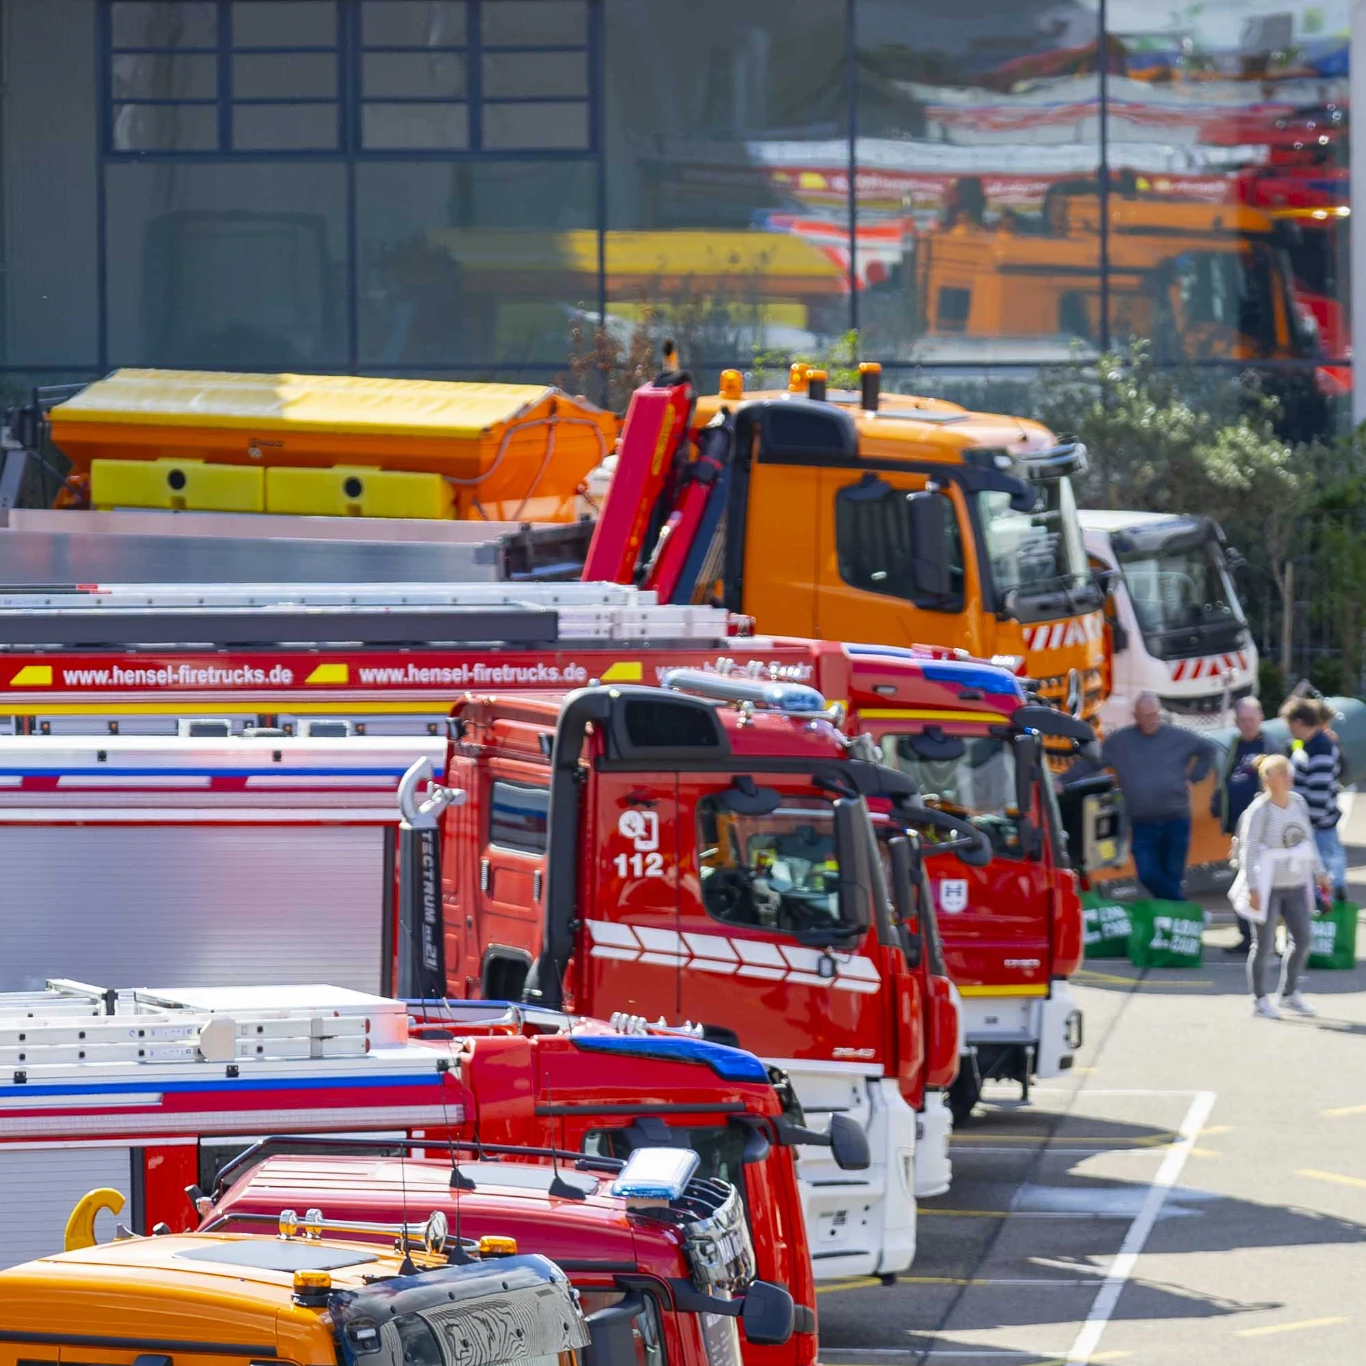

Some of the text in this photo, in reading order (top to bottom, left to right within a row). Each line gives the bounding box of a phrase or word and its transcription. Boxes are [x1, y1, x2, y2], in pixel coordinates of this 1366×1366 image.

[63, 664, 292, 686] www.hensel-firetrucks.de
[358, 663, 587, 686] www.hensel-firetrucks.de
[613, 852, 664, 878] 112
